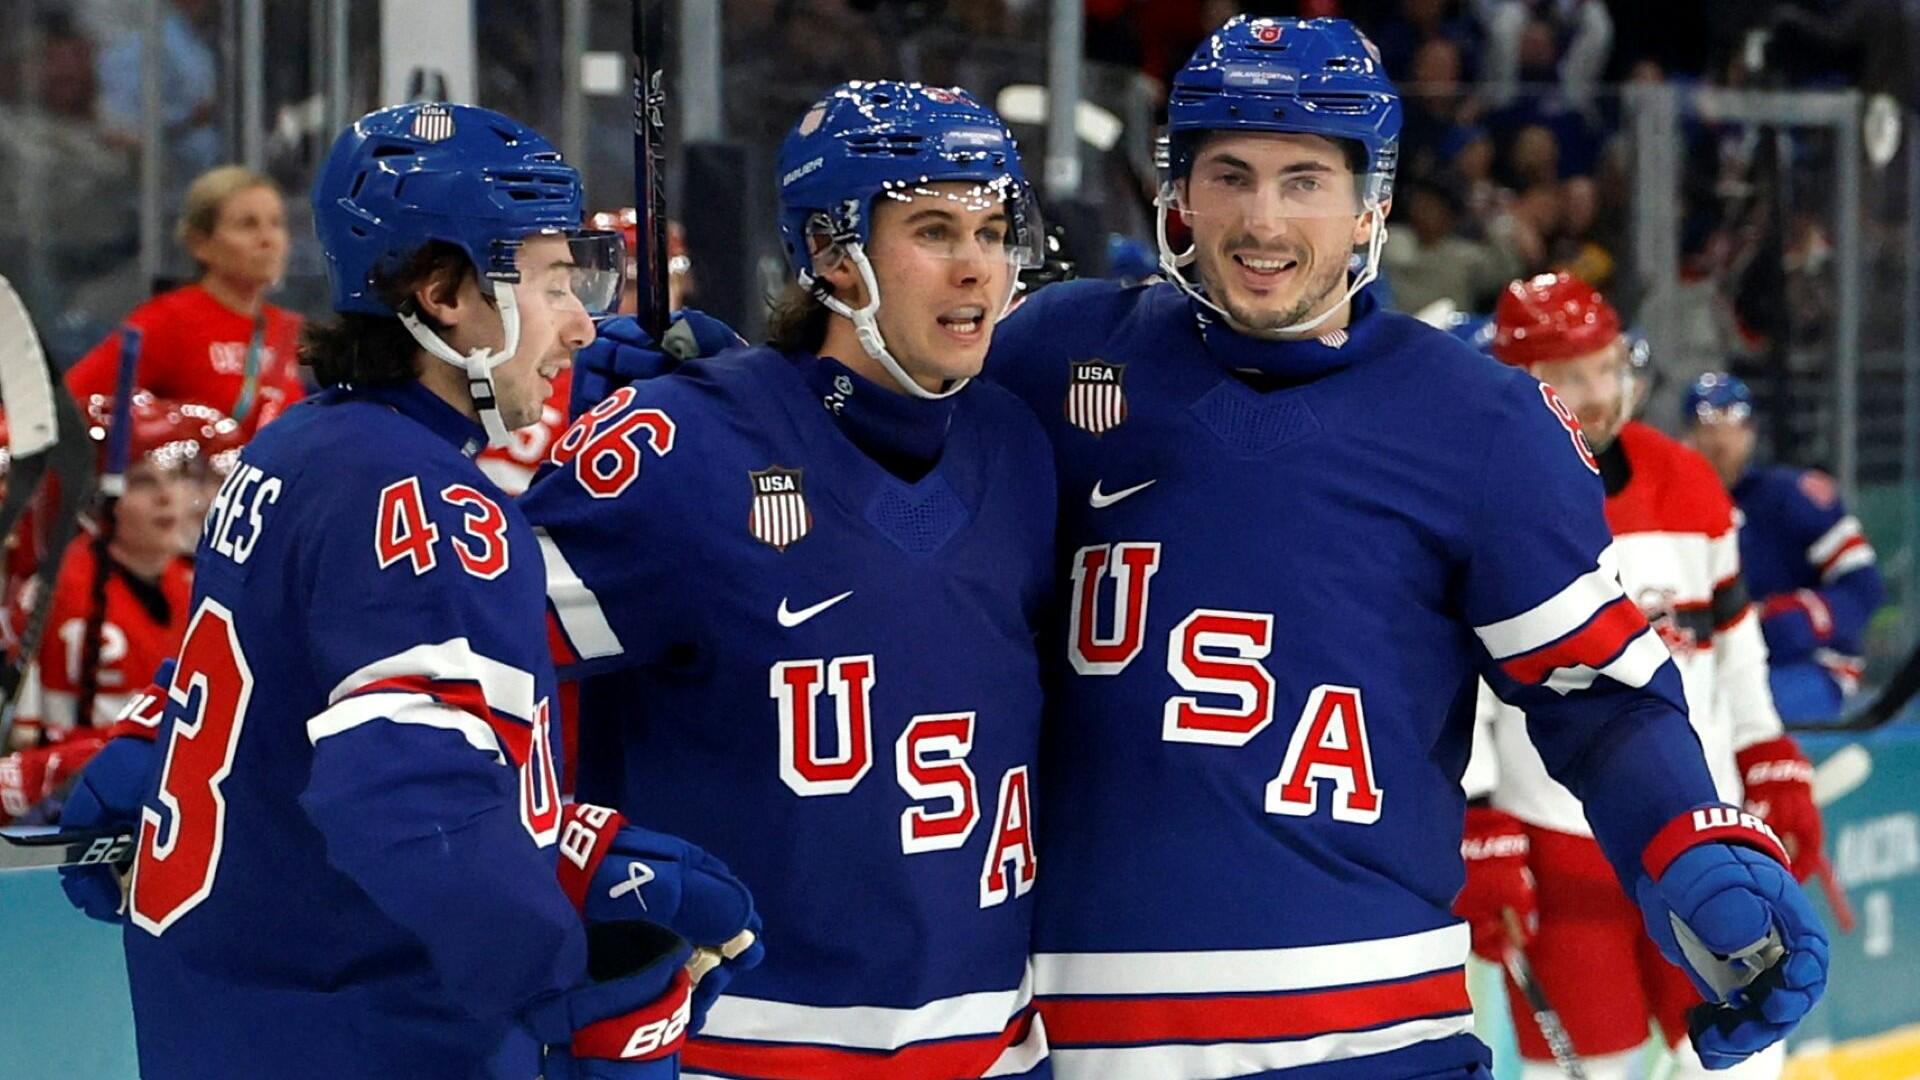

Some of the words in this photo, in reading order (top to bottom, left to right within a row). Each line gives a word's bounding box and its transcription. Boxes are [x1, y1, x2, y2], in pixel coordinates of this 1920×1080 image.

[783, 156, 824, 187] BAUER
[1078, 366, 1114, 381] USA
[552, 387, 676, 498] 86
[759, 475, 795, 492] USA
[204, 461, 283, 564] HES
[375, 476, 509, 580] 43
[58, 617, 128, 687] 12
[1068, 542, 1384, 825] USA
[130, 596, 254, 937] 3
[770, 654, 1037, 909] USA
